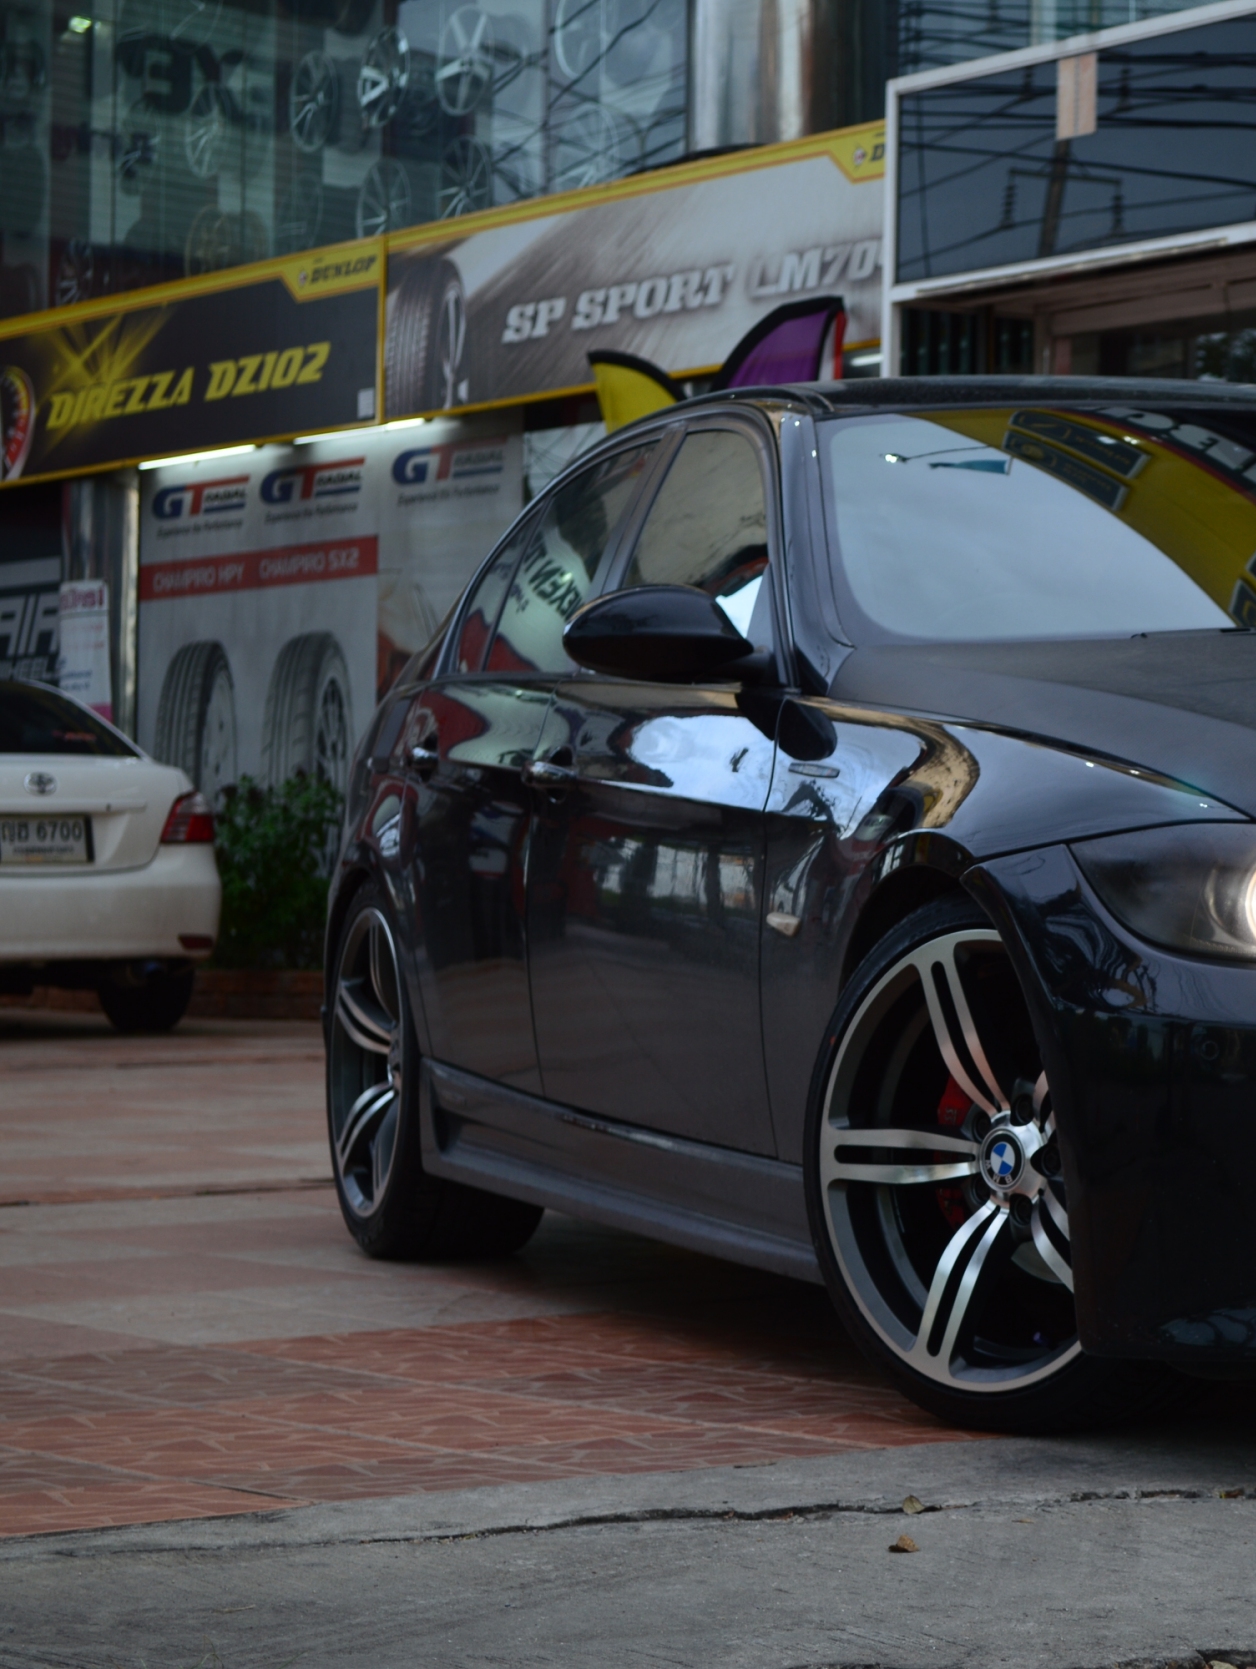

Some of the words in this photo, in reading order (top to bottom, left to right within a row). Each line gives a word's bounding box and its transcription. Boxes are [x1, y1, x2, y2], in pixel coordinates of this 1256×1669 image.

[312, 254, 377, 284] DUNLOP
[502, 296, 567, 344] SP
[570, 265, 735, 331] SPORT
[750, 239, 883, 298] LM70
[46, 366, 195, 431] DIREZZA
[261, 457, 365, 505] GT
[392, 436, 508, 484] GT
[153, 476, 249, 520] GT
[36, 820, 83, 842] 6700
